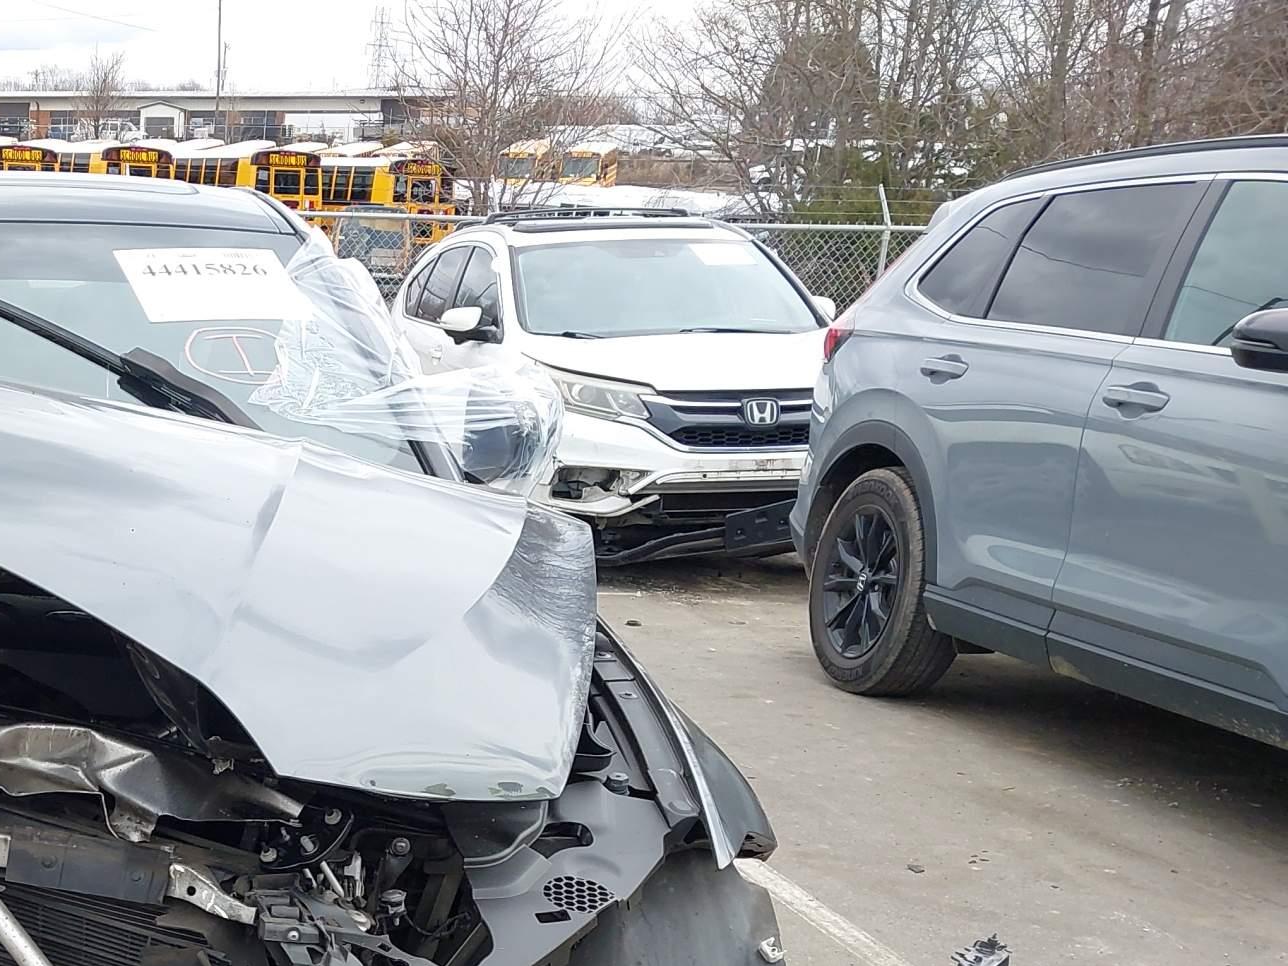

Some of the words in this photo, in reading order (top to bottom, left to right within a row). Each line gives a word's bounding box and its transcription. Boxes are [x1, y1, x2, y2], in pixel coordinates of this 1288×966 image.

[2, 149, 26, 159] SCHOOL
[28, 150, 42, 160] BUS
[120, 150, 143, 160] SCHOOL
[145, 152, 158, 161] BUS
[270, 154, 292, 164] SCHOOL
[294, 156, 306, 166] BUS
[142, 263, 268, 276] 44415826
